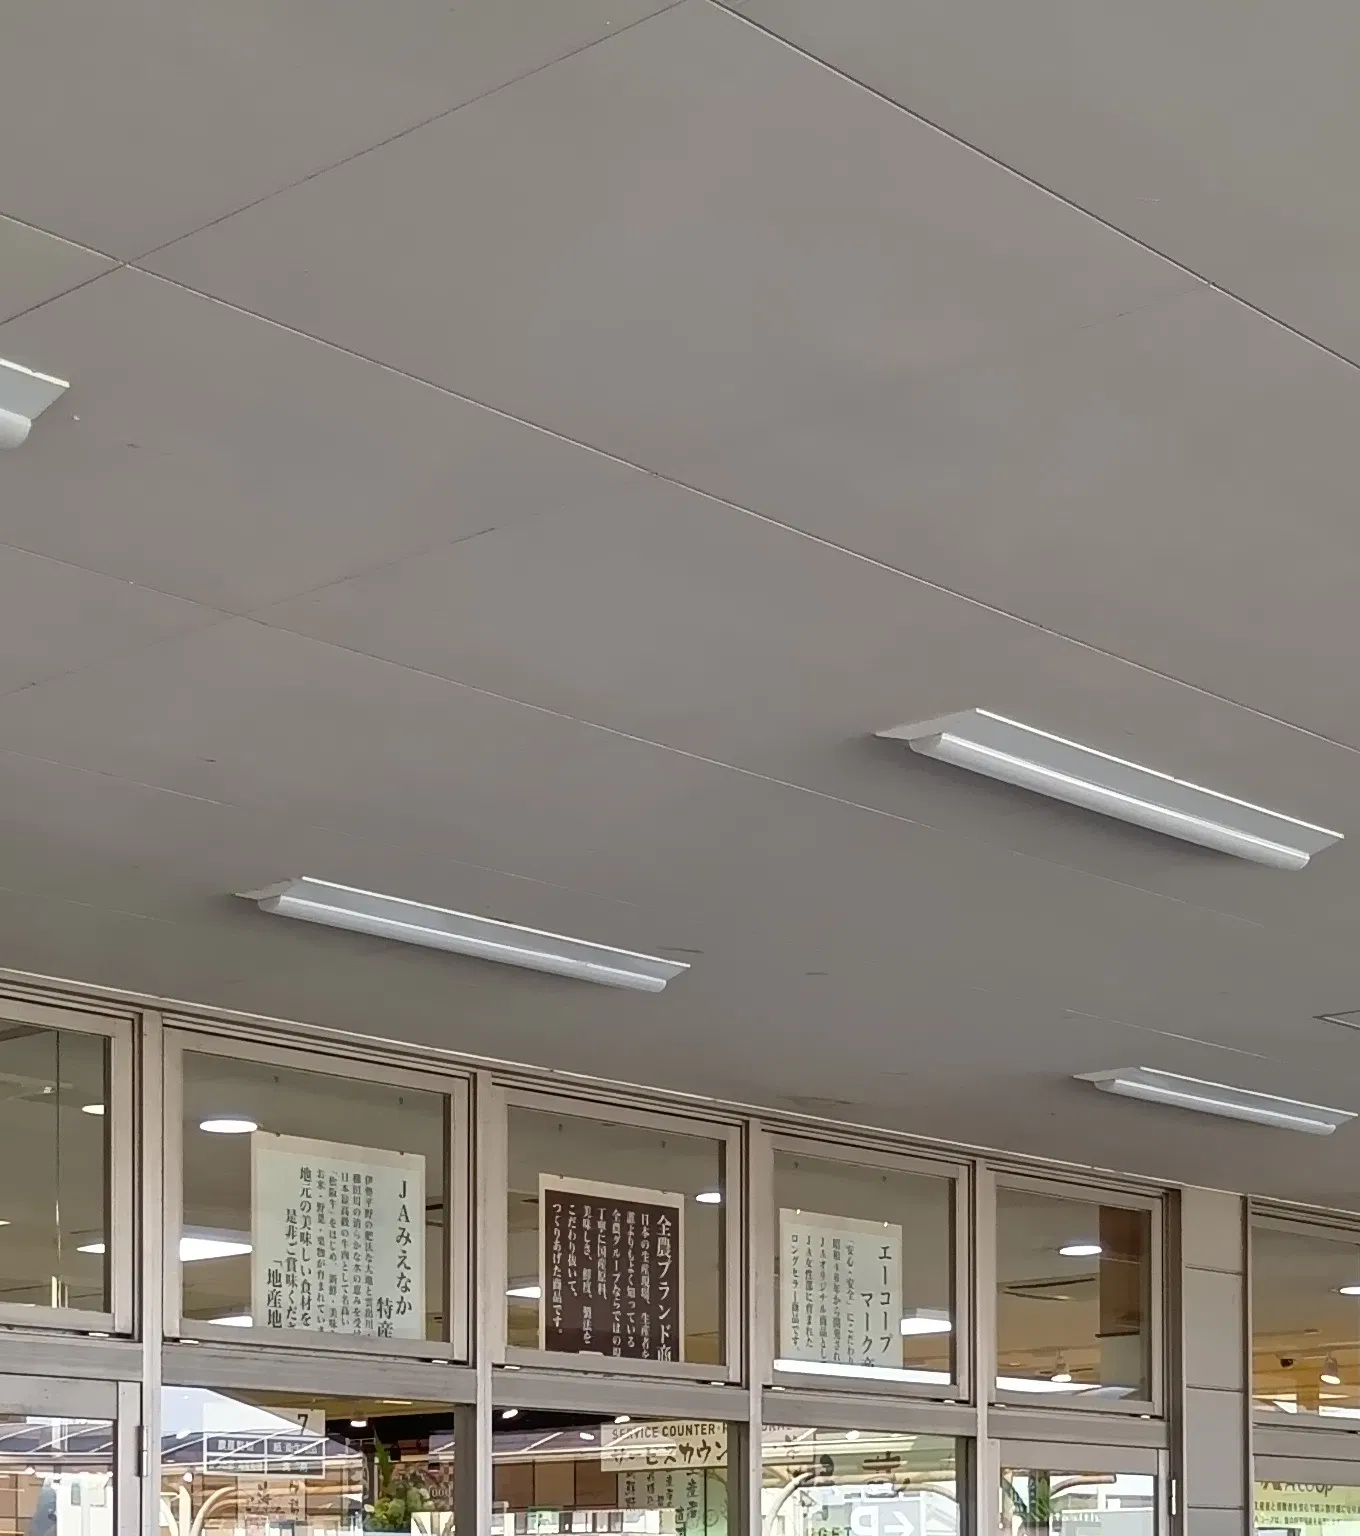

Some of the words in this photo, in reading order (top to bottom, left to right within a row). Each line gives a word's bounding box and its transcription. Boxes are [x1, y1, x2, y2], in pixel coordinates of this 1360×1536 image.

[878, 1245, 892, 1353] エーコープ
[662, 1423, 716, 1436] COUNTER
